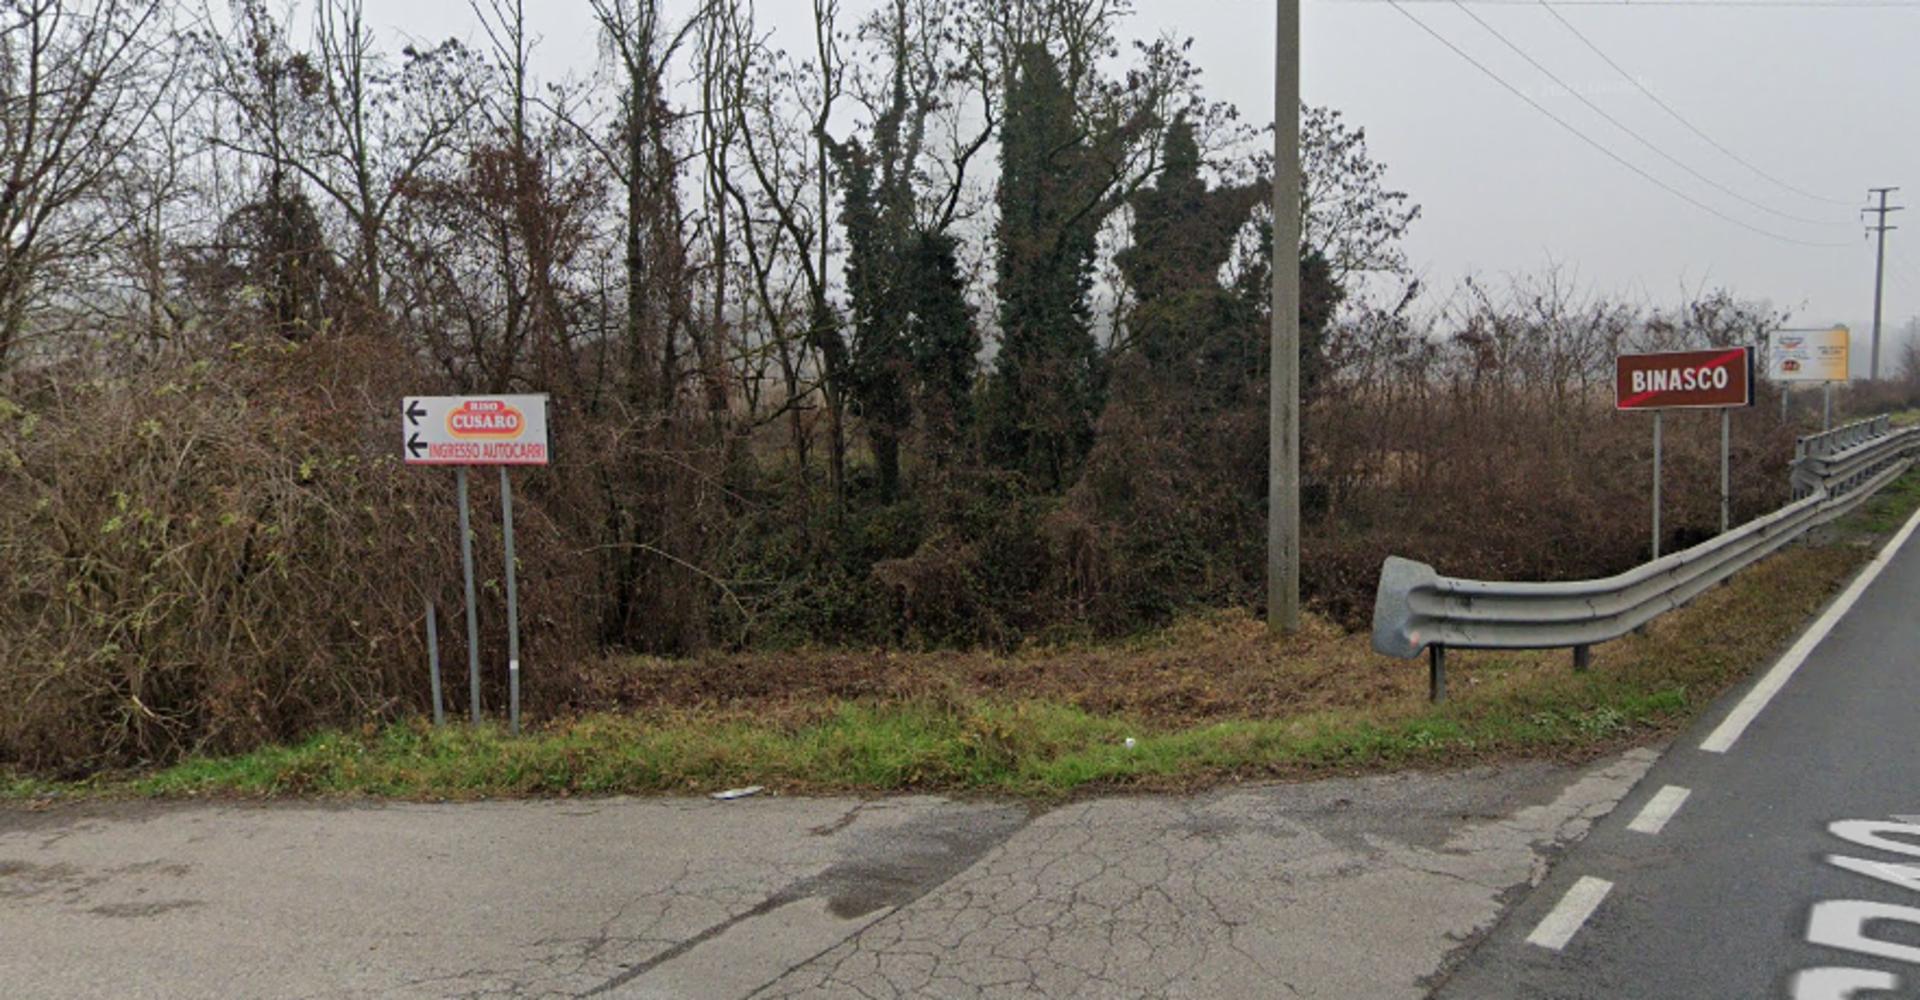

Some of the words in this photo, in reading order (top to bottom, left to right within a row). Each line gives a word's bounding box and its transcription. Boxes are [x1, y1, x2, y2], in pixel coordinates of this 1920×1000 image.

[1632, 366, 1728, 393] BINASCO
[452, 414, 518, 429] CUSARO
[429, 443, 480, 458] INGRESSO
[483, 442, 545, 458] AUTOCARRI
